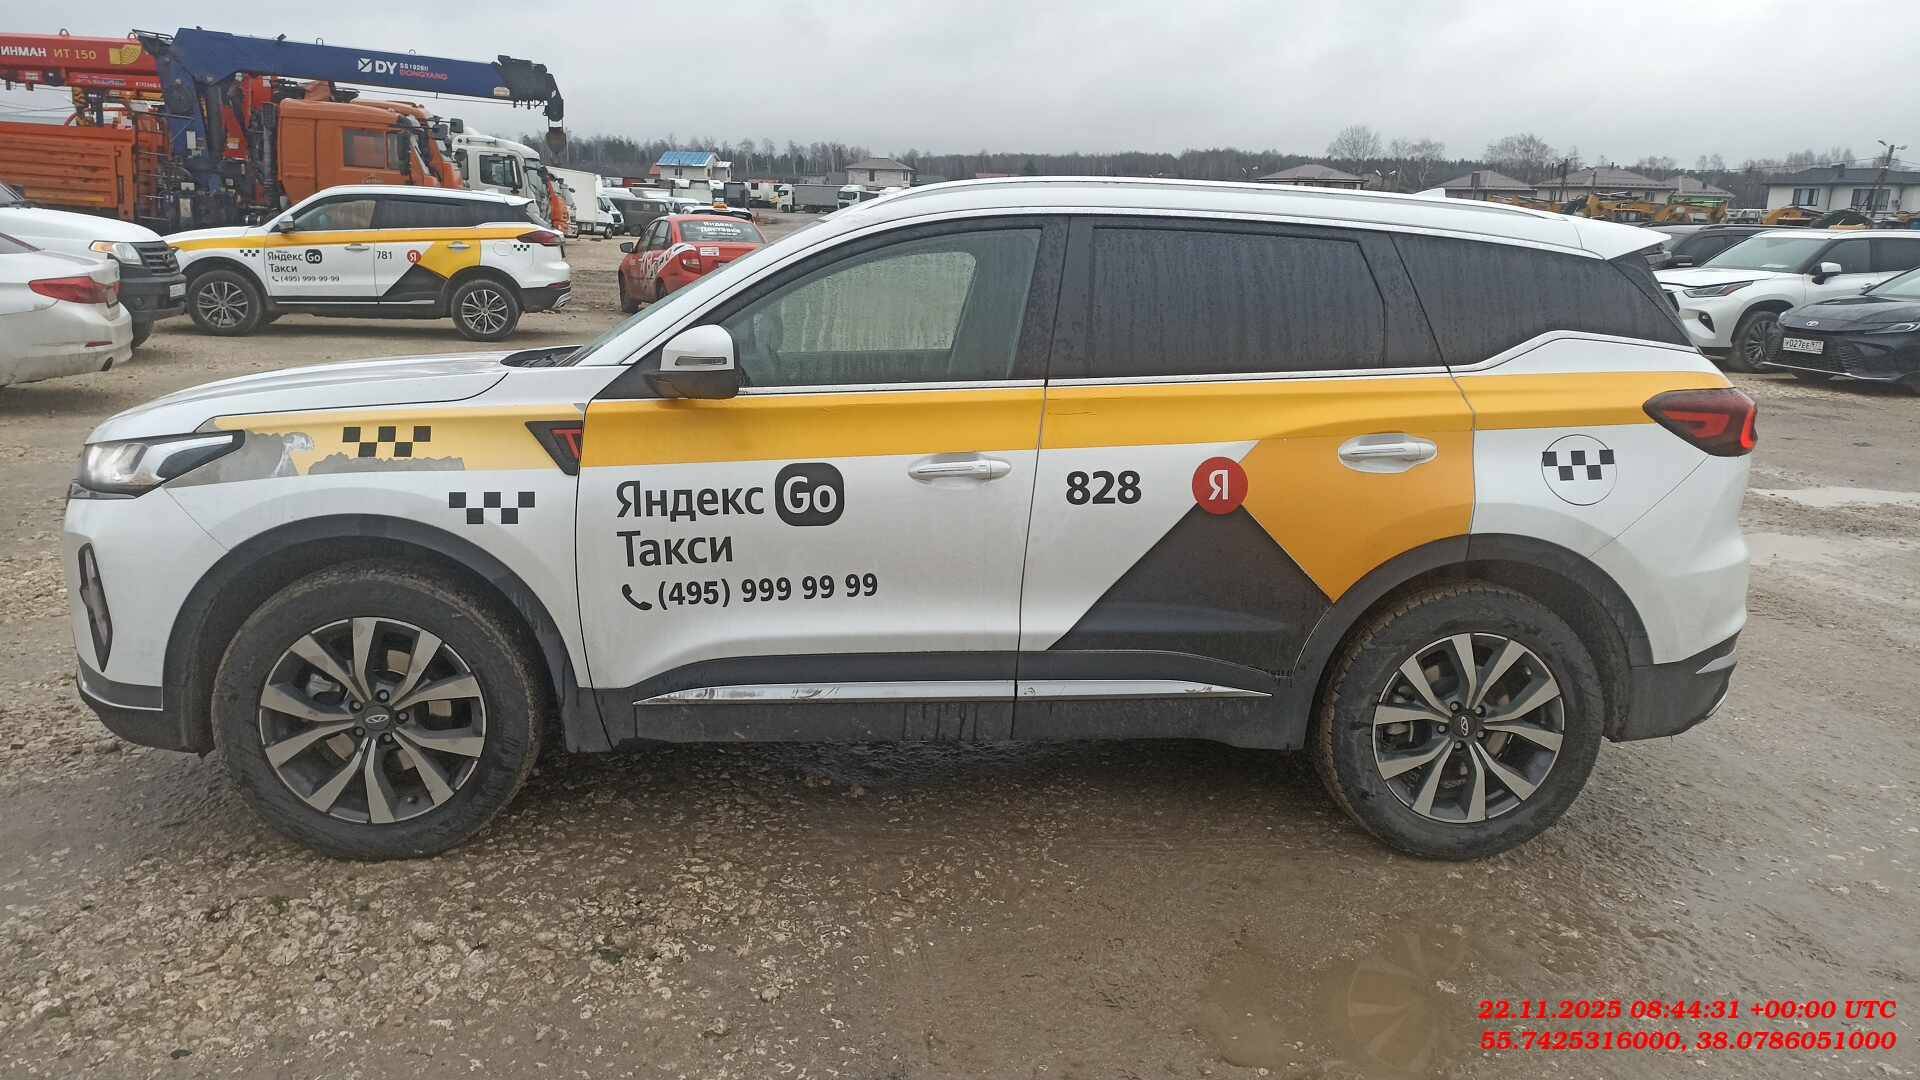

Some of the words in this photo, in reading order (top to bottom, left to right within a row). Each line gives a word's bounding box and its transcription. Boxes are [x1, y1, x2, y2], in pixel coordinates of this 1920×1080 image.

[75, 49, 97, 60] 150
[375, 60, 397, 75] DY
[267, 251, 304, 262] Яндекс
[306, 251, 321, 262] Go
[376, 250, 393, 260] 781
[268, 263, 298, 273] Такси
[1065, 470, 1142, 506] 828
[616, 480, 765, 521] Яндекс
[782, 475, 838, 515] Go
[616, 530, 733, 567] Такси
[658, 578, 731, 610] (495)
[741, 577, 792, 602] 999
[802, 574, 835, 600] 99
[845, 572, 878, 597] 99
